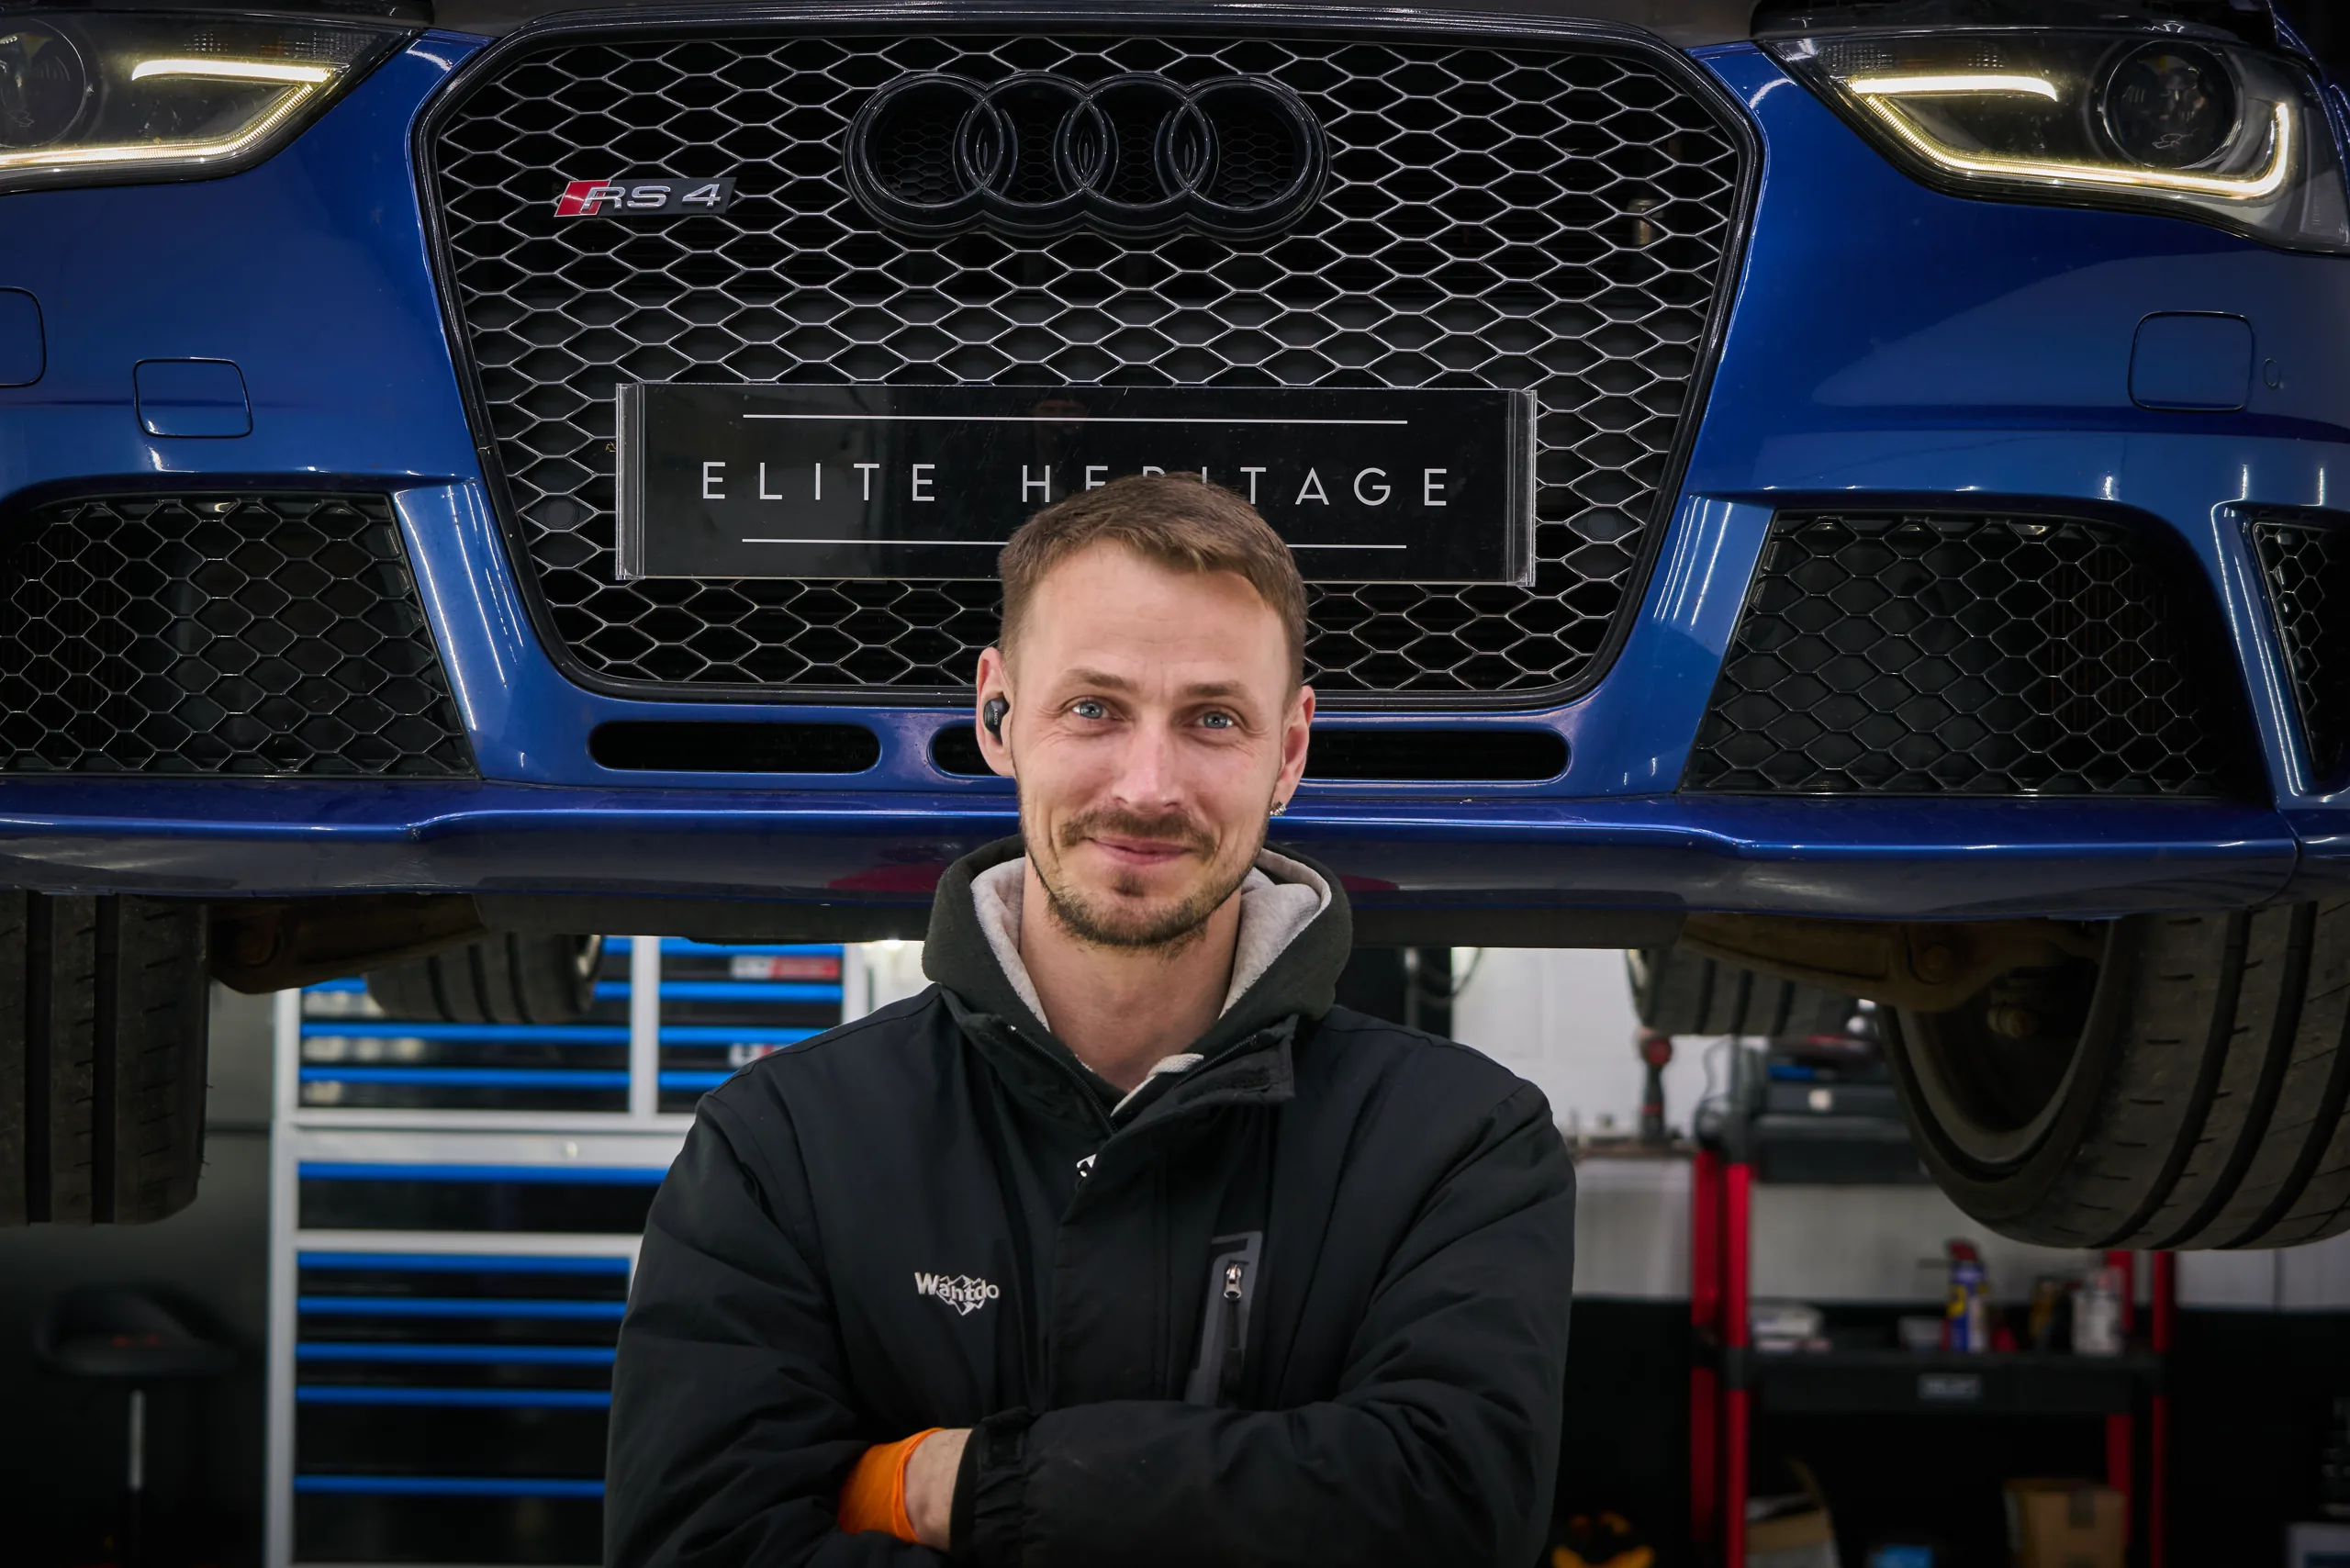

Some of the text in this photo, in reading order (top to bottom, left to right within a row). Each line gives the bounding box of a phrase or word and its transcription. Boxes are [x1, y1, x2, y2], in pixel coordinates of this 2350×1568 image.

[580, 184, 721, 210] RS 4
[702, 461, 935, 501] ELITE
[914, 1272, 1000, 1301] Wantdo
